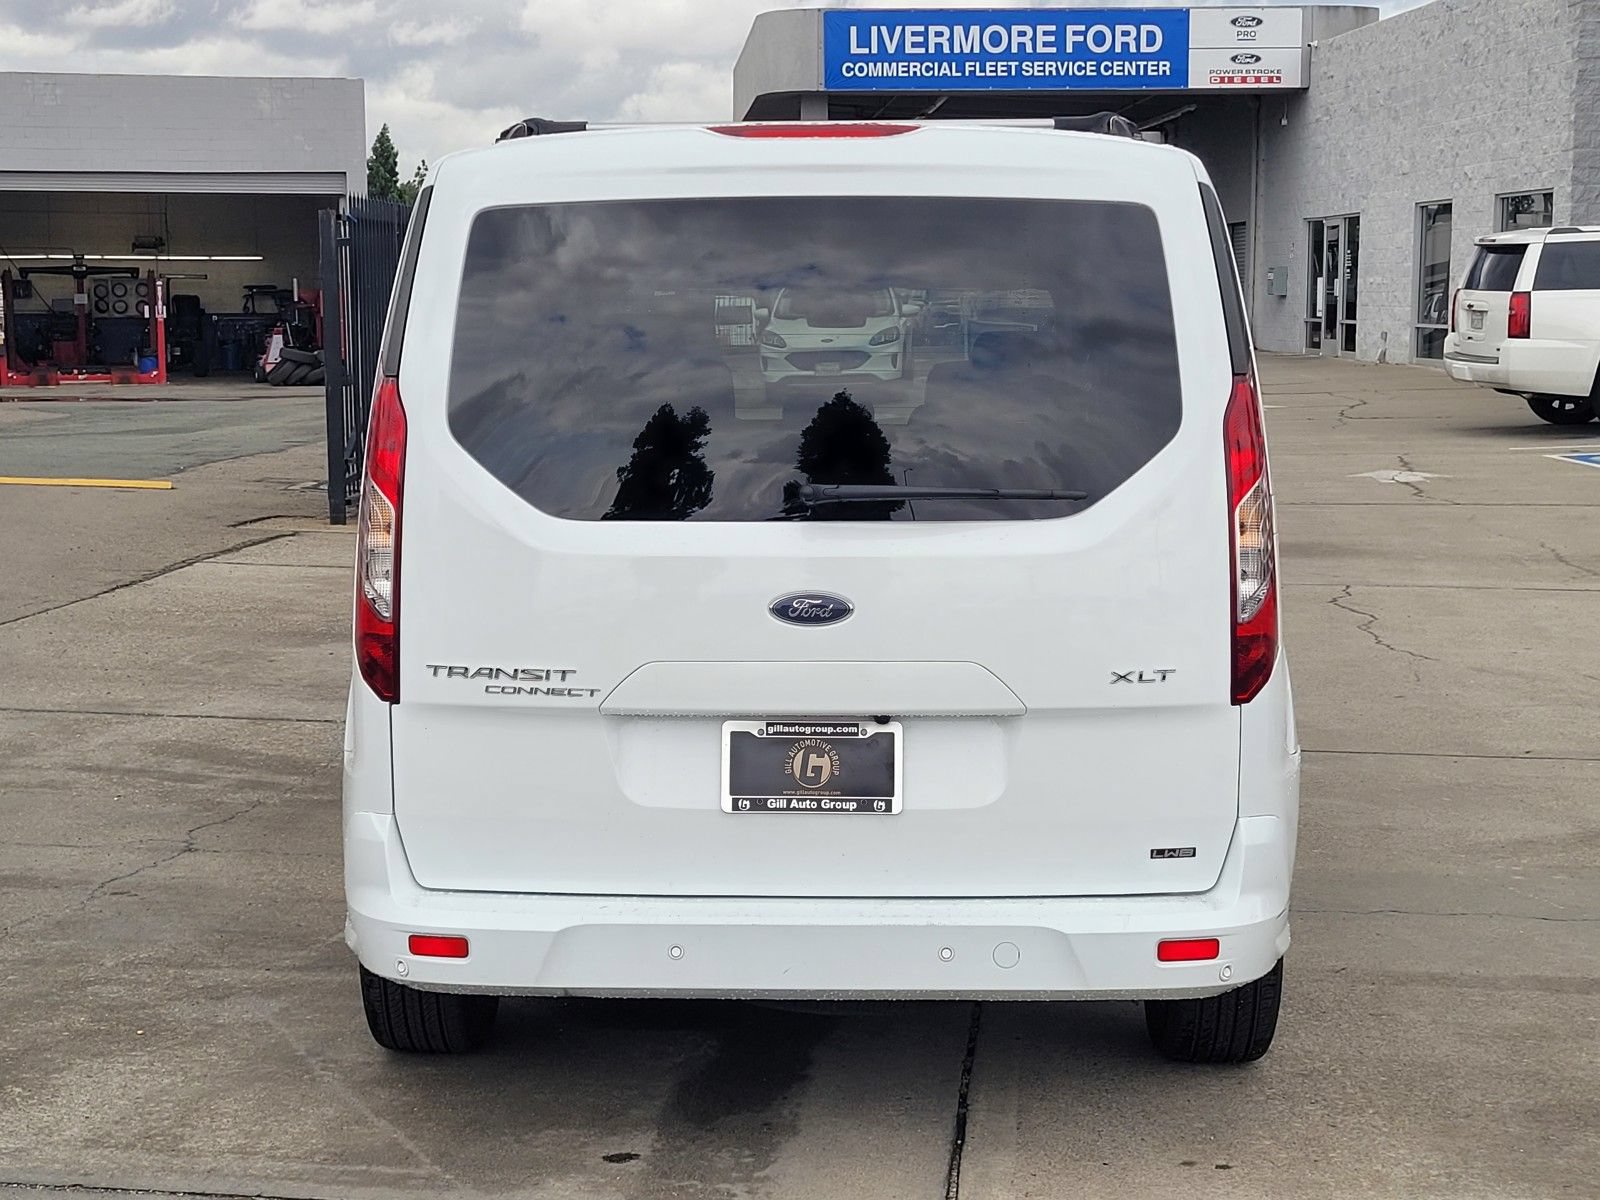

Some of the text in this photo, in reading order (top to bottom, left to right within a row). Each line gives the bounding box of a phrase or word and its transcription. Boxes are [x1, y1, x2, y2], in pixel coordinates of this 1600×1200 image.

[1234, 16, 1259, 28] Ford
[850, 24, 1164, 54] LIVERMORE FORD
[1236, 30, 1257, 38] PRO
[1234, 53, 1258, 64] Ford
[842, 60, 1171, 77] COMMERCIAL FLEET SERVICE CENTER
[1210, 76, 1281, 84] DIESEL
[788, 598, 834, 618] Ford
[425, 664, 577, 682] TRANSIT
[1110, 668, 1176, 684] XLT
[484, 685, 601, 698] CONNECT
[767, 723, 858, 735] gillautogroup.com
[784, 739, 840, 776] GILL AUTOMOTIVE GROUP
[767, 799, 787, 809] Gill
[790, 799, 817, 809] Auto
[820, 799, 857, 811] Group
[1152, 848, 1194, 858] LWB
